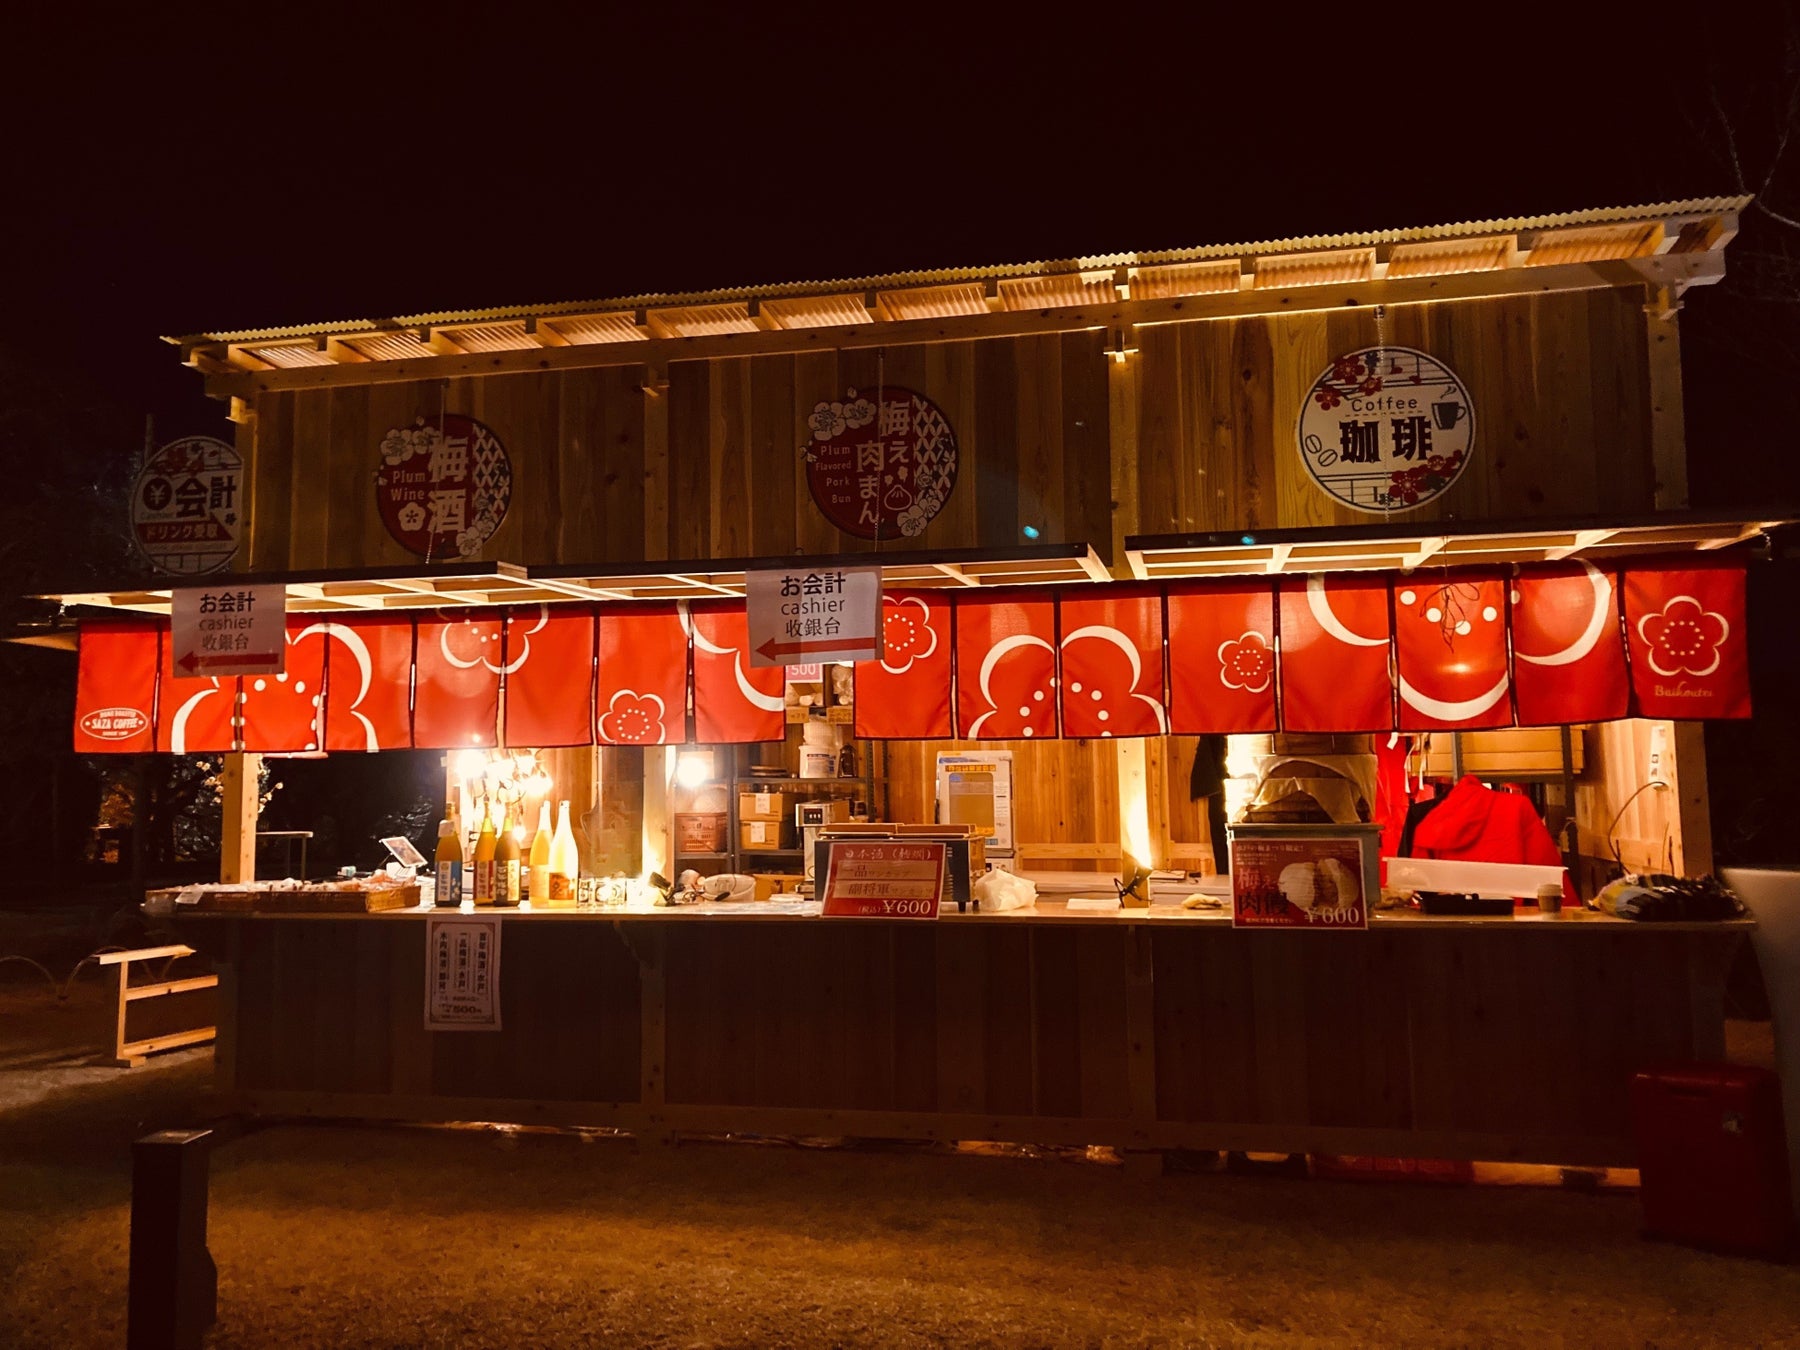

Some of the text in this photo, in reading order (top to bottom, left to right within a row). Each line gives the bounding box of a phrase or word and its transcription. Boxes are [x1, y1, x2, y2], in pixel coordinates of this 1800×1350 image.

[1351, 396, 1418, 413] Coffee
[1338, 415, 1433, 464] 珈琲
[820, 445, 851, 456] Plum
[815, 460, 852, 471] Flavored
[392, 470, 426, 483] Plum
[426, 435, 469, 534] 梅酒
[856, 439, 886, 525] 肉まん
[175, 475, 237, 518] 会計
[390, 488, 425, 502] Wine
[832, 494, 851, 504] Bun
[780, 572, 846, 597] お会計
[199, 591, 256, 614] お会計
[781, 598, 845, 615] cashier
[198, 614, 254, 631] cashier
[791, 664, 816, 676] 500
[91, 717, 138, 730] SAZA COFFEE
[882, 900, 931, 914] ¥600
[1304, 907, 1360, 924] ¥600
